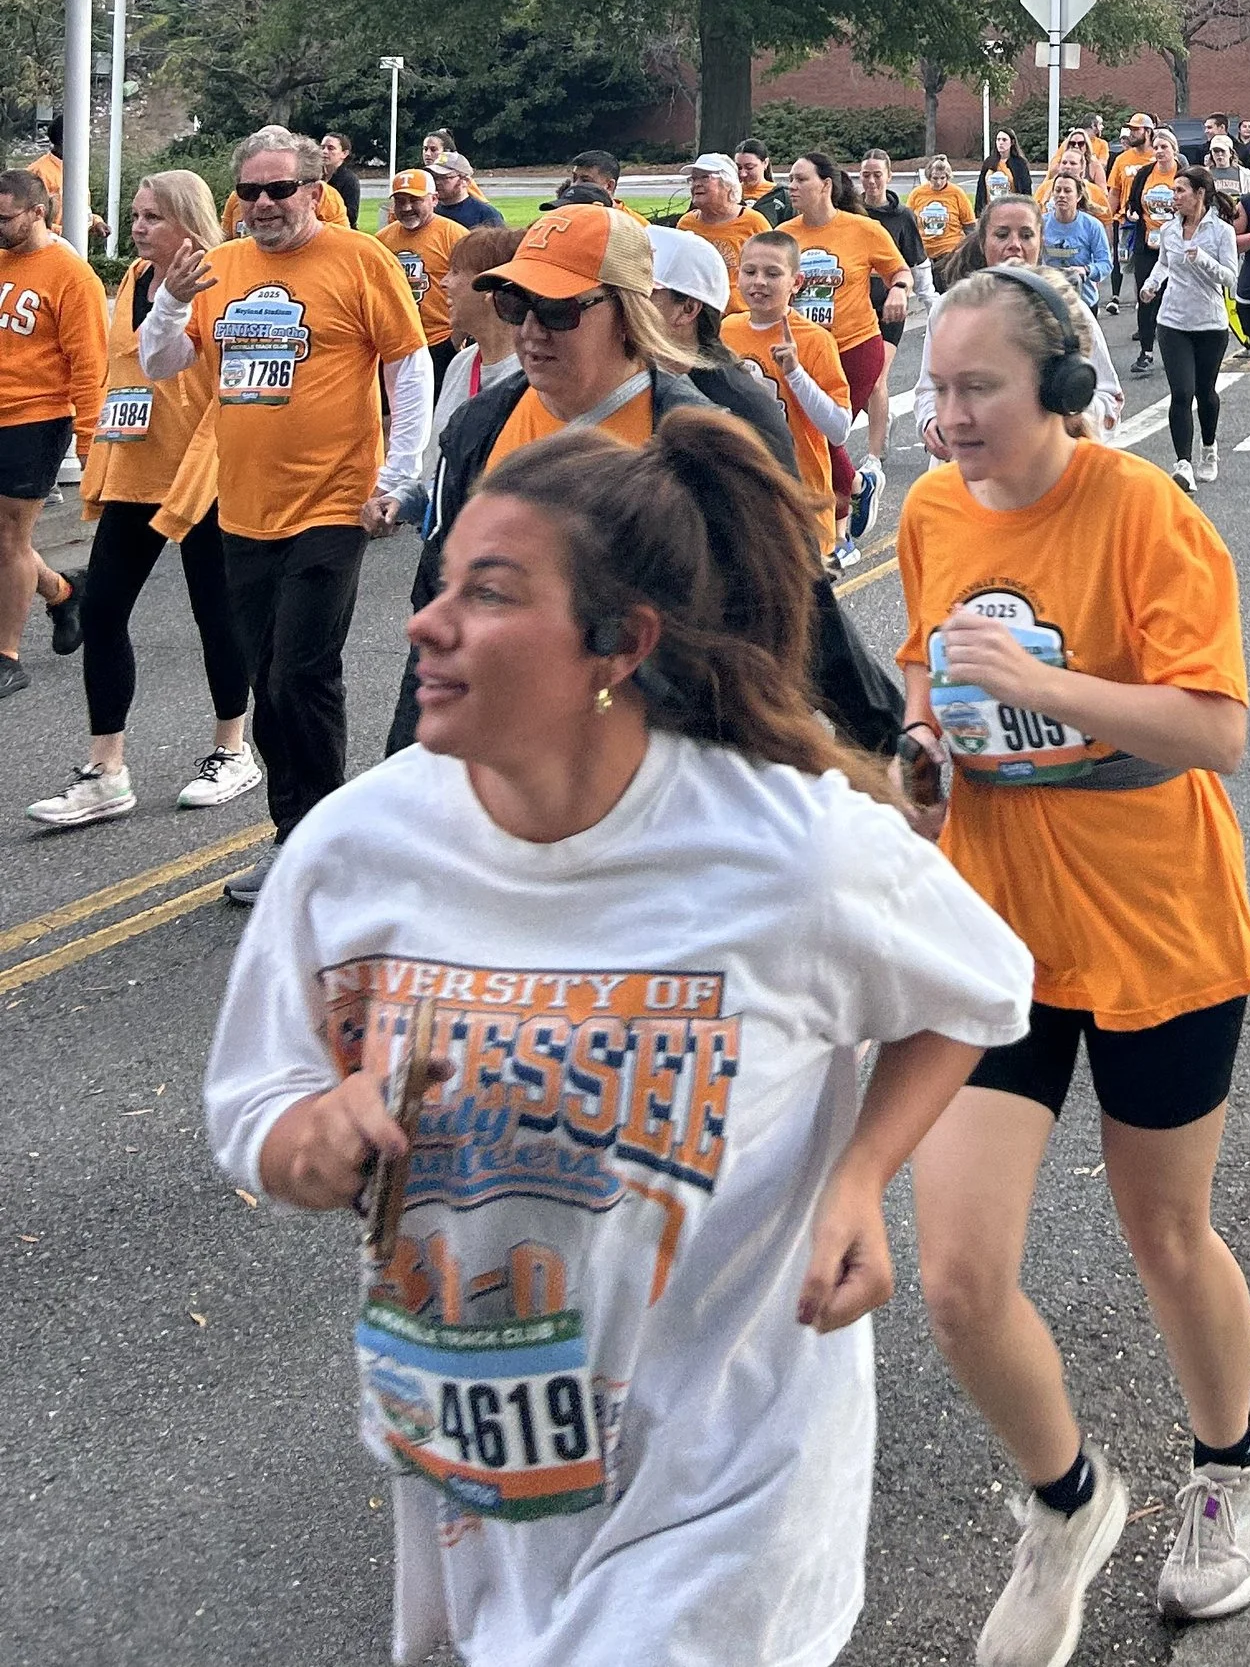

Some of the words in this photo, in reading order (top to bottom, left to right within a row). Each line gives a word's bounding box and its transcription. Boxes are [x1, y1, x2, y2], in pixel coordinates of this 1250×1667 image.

[399, 173, 414, 187] T
[527, 216, 573, 249] T
[806, 307, 832, 323] 1664
[216, 323, 272, 338] FINISH
[247, 360, 291, 387] 1786
[112, 403, 148, 426] 1984
[975, 604, 1017, 618] 2025
[644, 979, 717, 1011] OF
[441, 1376, 589, 1467] 4619
